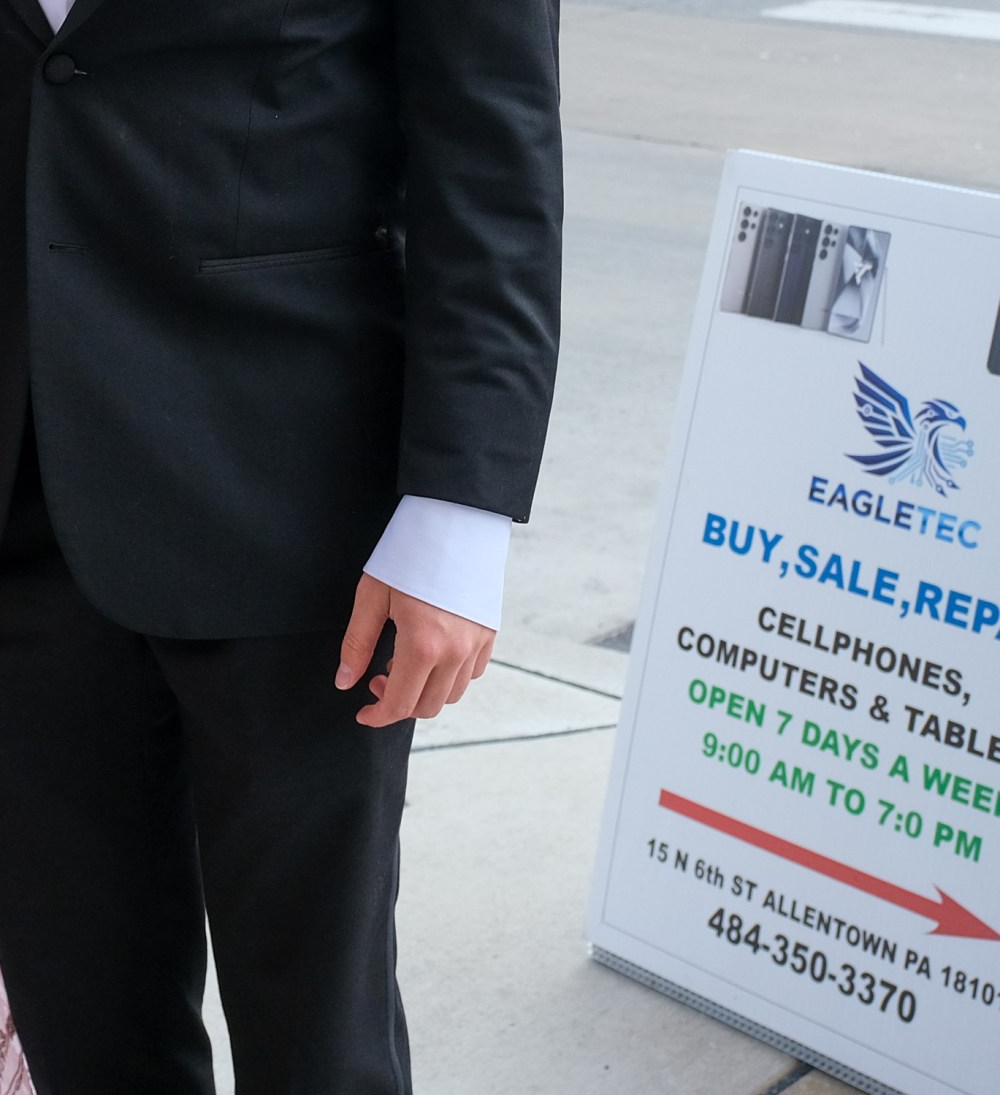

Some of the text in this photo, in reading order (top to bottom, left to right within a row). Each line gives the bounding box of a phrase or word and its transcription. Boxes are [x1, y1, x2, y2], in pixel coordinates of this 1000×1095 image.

[807, 475, 982, 549] EAGLETEC
[702, 512, 1000, 641] BUY,SALE,REP
[677, 626, 858, 711] COMPUTERS
[869, 694, 890, 724] &
[758, 606, 971, 706] CELLPHONES,
[688, 678, 766, 728] OPEN
[776, 709, 793, 736] 7
[801, 719, 880, 771] DAYS
[888, 754, 909, 784] A
[702, 732, 983, 863] 9:00 AM TO 7:0 PM
[647, 838, 1000, 1007] 15 N 6th ST ALLENTOWN PA 1810
[707, 907, 917, 1024] 484-350-3370
